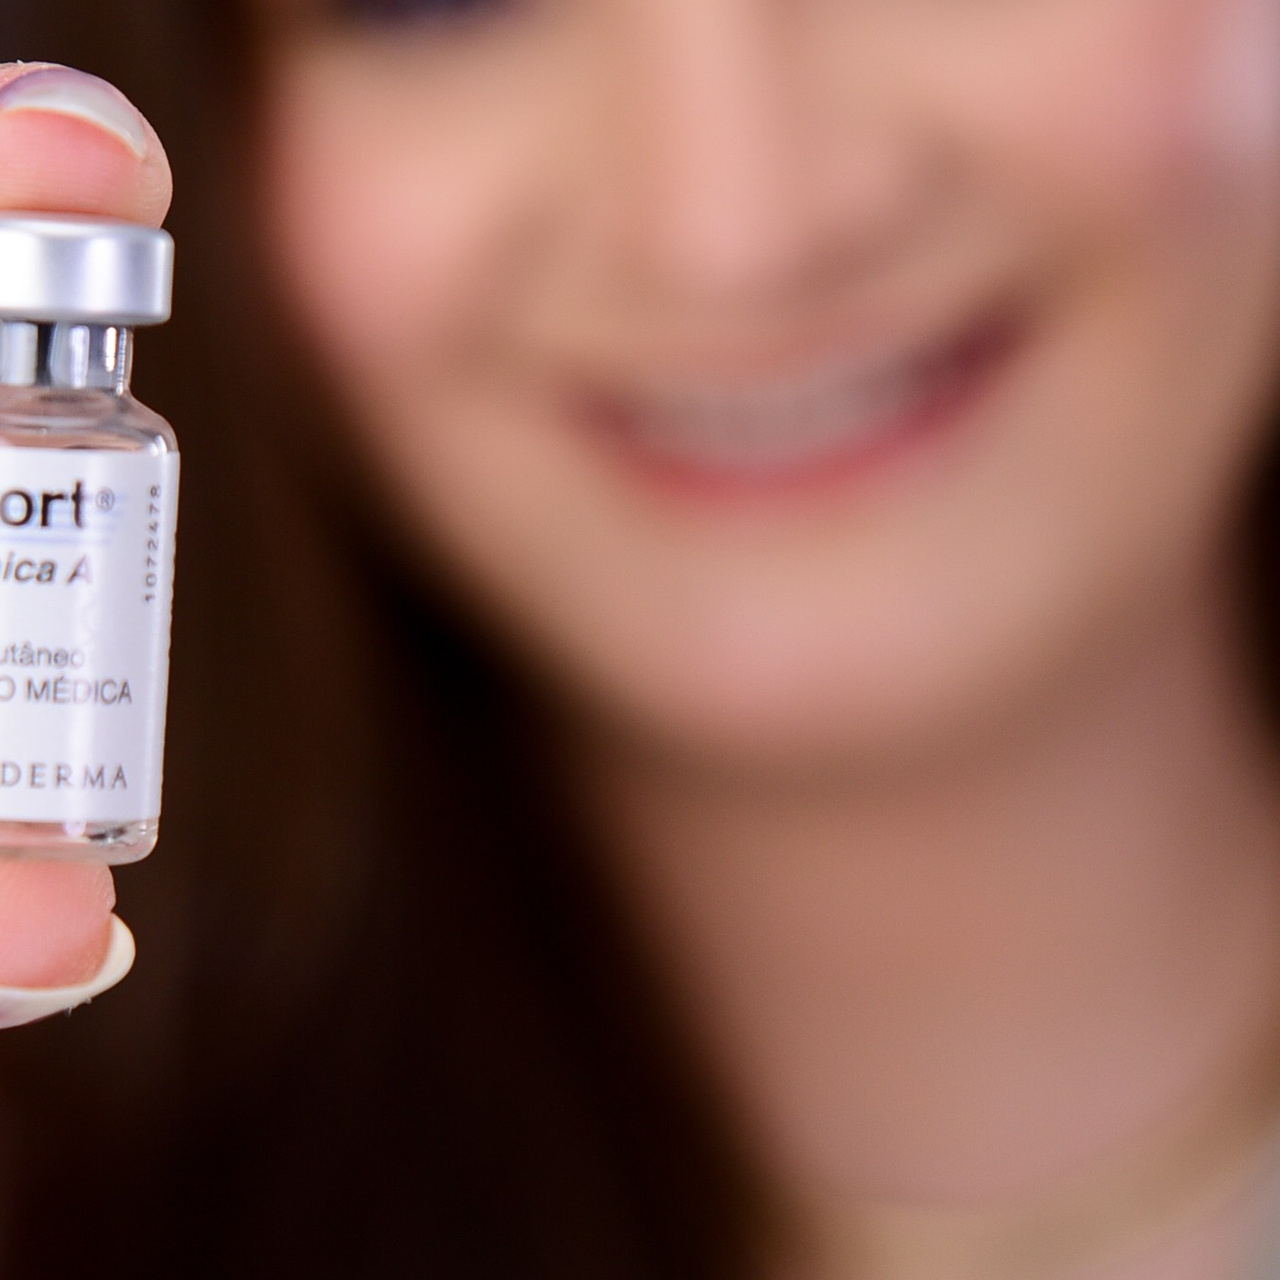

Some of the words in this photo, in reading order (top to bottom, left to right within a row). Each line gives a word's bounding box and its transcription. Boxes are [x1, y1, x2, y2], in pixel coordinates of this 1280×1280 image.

[145, 484, 160, 602] 1072478
[67, 555, 93, 584] A
[26, 675, 132, 704] MÉDICA
